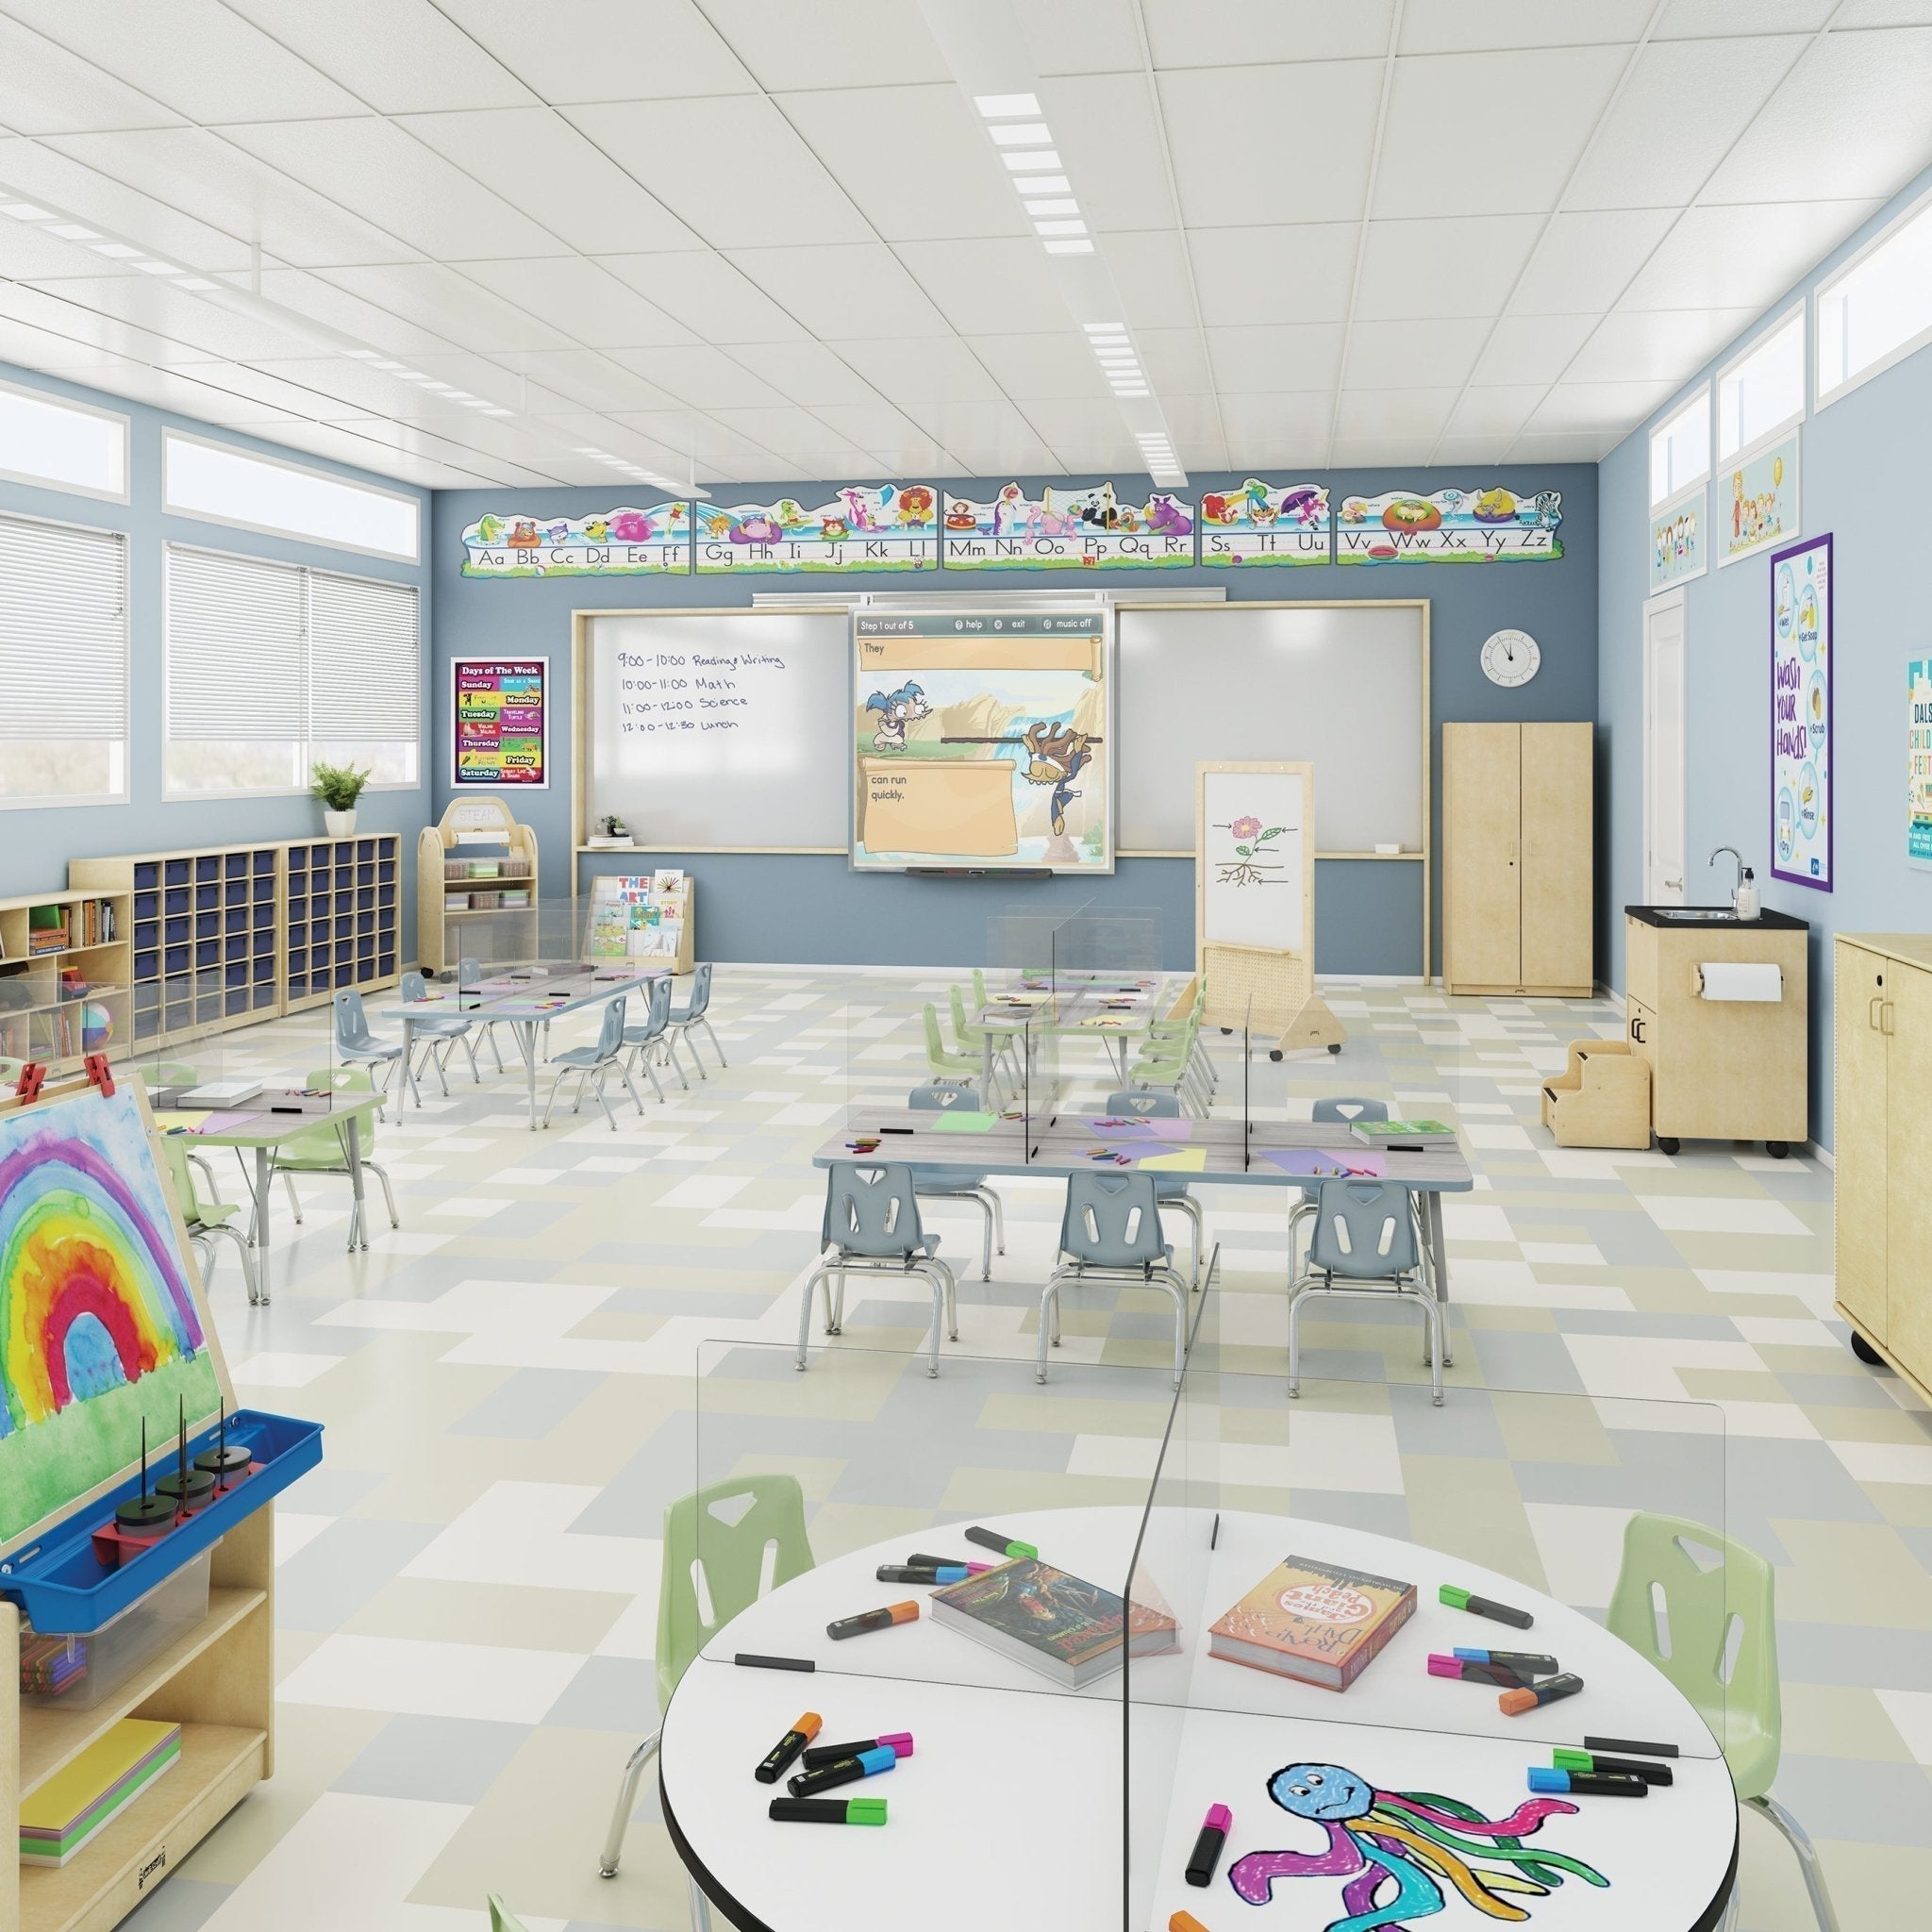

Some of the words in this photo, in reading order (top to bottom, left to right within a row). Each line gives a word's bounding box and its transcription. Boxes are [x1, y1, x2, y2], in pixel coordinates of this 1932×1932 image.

[1210, 535, 1230, 552] Ss
[1257, 534, 1276, 551] Tt
[1298, 533, 1324, 550] Uu
[1345, 532, 1371, 549] Vv
[1389, 532, 1431, 548] Ww
[1441, 530, 1467, 547] Xx
[1481, 530, 1507, 554] Yy
[1521, 529, 1547, 546] Zz
[950, 540, 986, 557] Mm
[996, 539, 1023, 556] Nn
[1035, 538, 1065, 555] Oo
[1085, 537, 1108, 560] Pp
[1119, 536, 1154, 560] Qq
[1165, 536, 1188, 553] Rr
[478, 550, 505, 565] Aa
[517, 549, 540, 564] Bb
[550, 548, 574, 563] Cc
[587, 547, 609, 563] Dd
[627, 546, 648, 563] Ee
[663, 546, 680, 562] Ff
[706, 543, 733, 567] Gg
[749, 543, 774, 559] Hh
[791, 542, 801, 558] Ii
[825, 541, 842, 565] Jj
[866, 541, 889, 558] Kk
[910, 541, 925, 557] Ll
[860, 621, 878, 632] Step
[884, 622, 896, 630] out
[898, 621, 908, 630] of
[908, 621, 914, 630] 5
[965, 620, 983, 631] help
[1011, 619, 1025, 628] exit
[1056, 619, 1078, 628] music
[1079, 618, 1092, 628] off
[864, 642, 885, 656] They
[692, 654, 737, 671] Reading
[740, 654, 786, 669] Writing
[462, 666, 483, 676] Days
[484, 666, 493, 675] of
[494, 666, 512, 675] The
[513, 666, 538, 675] Week
[461, 681, 492, 690] Sunday
[694, 677, 736, 690] Math
[507, 696, 540, 705] Monday
[699, 697, 748, 708] Science
[461, 710, 496, 719] Tuesday
[700, 720, 739, 731] Lunch
[462, 740, 499, 748] Thursday
[507, 756, 535, 765] Friday
[461, 769, 499, 777] Saturday
[871, 776, 889, 785] can
[891, 776, 907, 785] run
[871, 789, 905, 802] quickly.
[618, 876, 648, 890] THE
[619, 891, 648, 904] ART
[1284, 1590, 1369, 1617] Giant
[1303, 1624, 1362, 1645] DAHL
